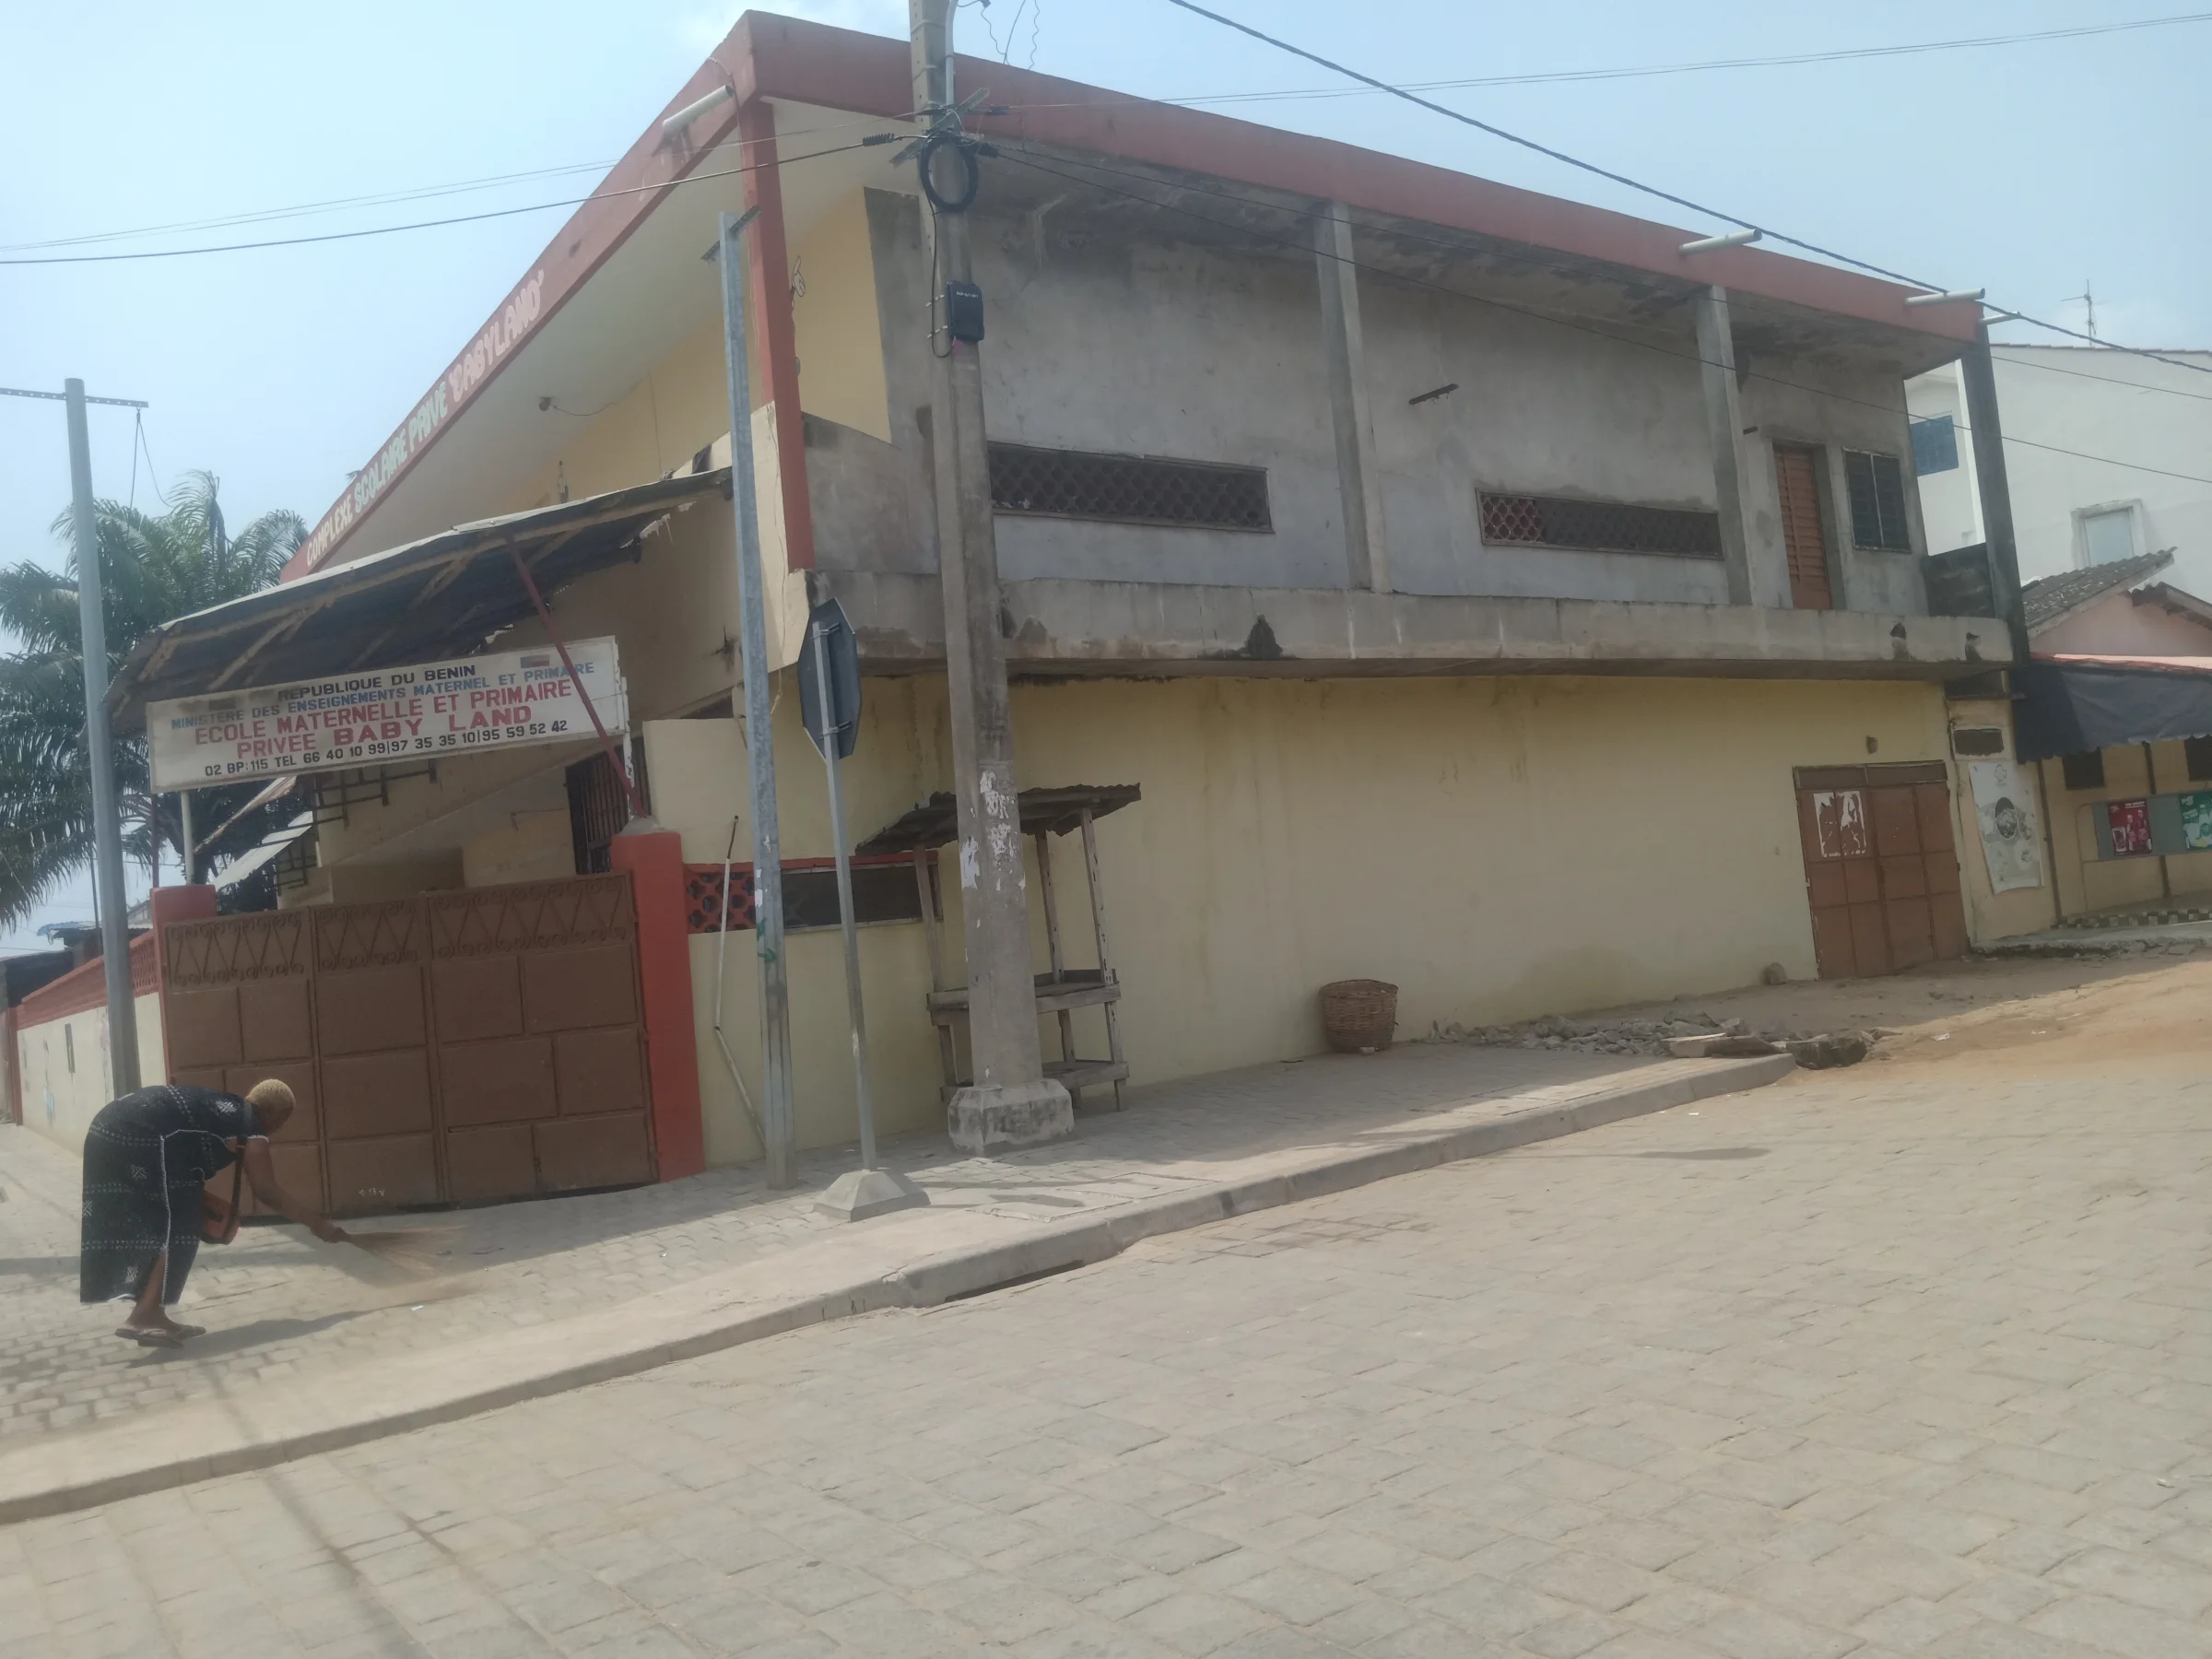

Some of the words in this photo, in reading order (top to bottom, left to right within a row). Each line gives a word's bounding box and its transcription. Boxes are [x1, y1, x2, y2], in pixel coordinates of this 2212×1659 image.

[307, 493, 353, 567] COMPLEXE
[354, 428, 407, 513] SCOLAIRE
[171, 710, 244, 730] MINISTERE
[252, 705, 280, 719] DES
[288, 687, 406, 713] ENSEIGNEMENTS
[414, 677, 490, 696] MATERNEL
[499, 673, 516, 686] ET
[524, 662, 594, 682] PRIMARE
[195, 720, 266, 746] ECOLE
[276, 698, 423, 735] MATERNELLE
[433, 693, 459, 713] ET
[470, 678, 571, 710] PRIMAIRE
[277, 677, 382, 701] REPUBLIQUE
[391, 673, 415, 686] DU
[424, 665, 476, 681] BENIN
[205, 764, 222, 777] 02
[275, 754, 297, 768] TEL
[303, 751, 321, 764] 66
[325, 748, 344, 760] 40
[349, 746, 363, 758] 10
[415, 737, 433, 749] 35
[439, 734, 456, 747] 35
[506, 725, 524, 738] 59
[529, 723, 547, 735] 52
[551, 720, 568, 733] 42
[237, 733, 316, 759] PRIVEE
[334, 718, 423, 747] BABY
[449, 705, 532, 732] LAND
